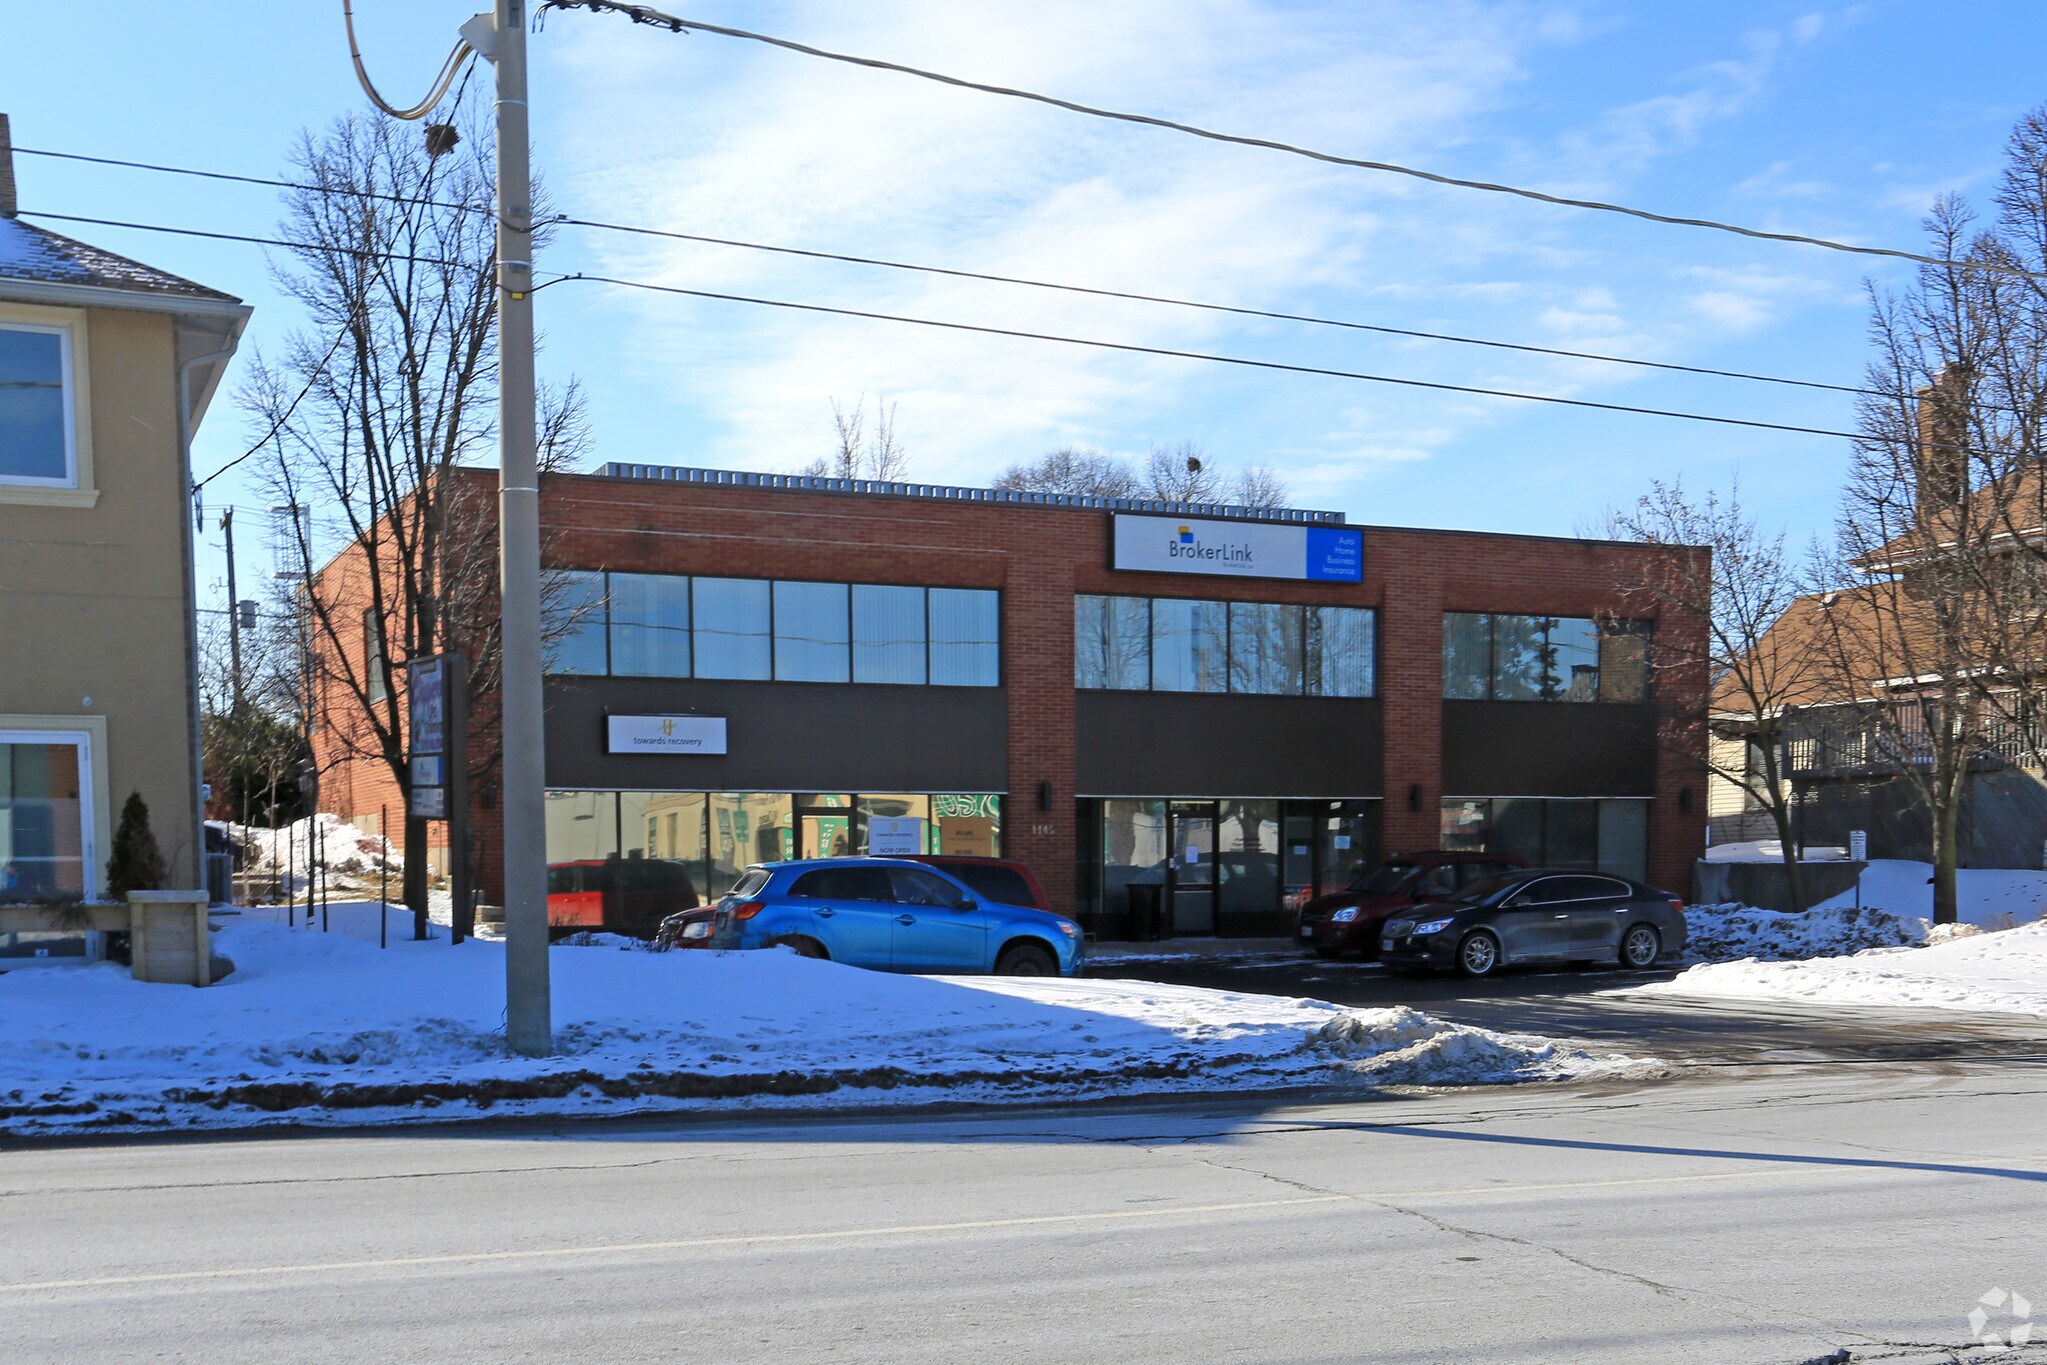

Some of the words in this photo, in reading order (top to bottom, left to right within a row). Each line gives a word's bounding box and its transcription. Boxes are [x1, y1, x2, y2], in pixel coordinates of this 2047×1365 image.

[1338, 537, 1355, 546] Auto
[1170, 540, 1253, 561] BrokerLink
[1334, 546, 1356, 555] Home
[1326, 555, 1356, 566] Business
[1322, 565, 1356, 576] Insurance
[633, 737, 666, 745] towards
[667, 738, 702, 747] recovery
